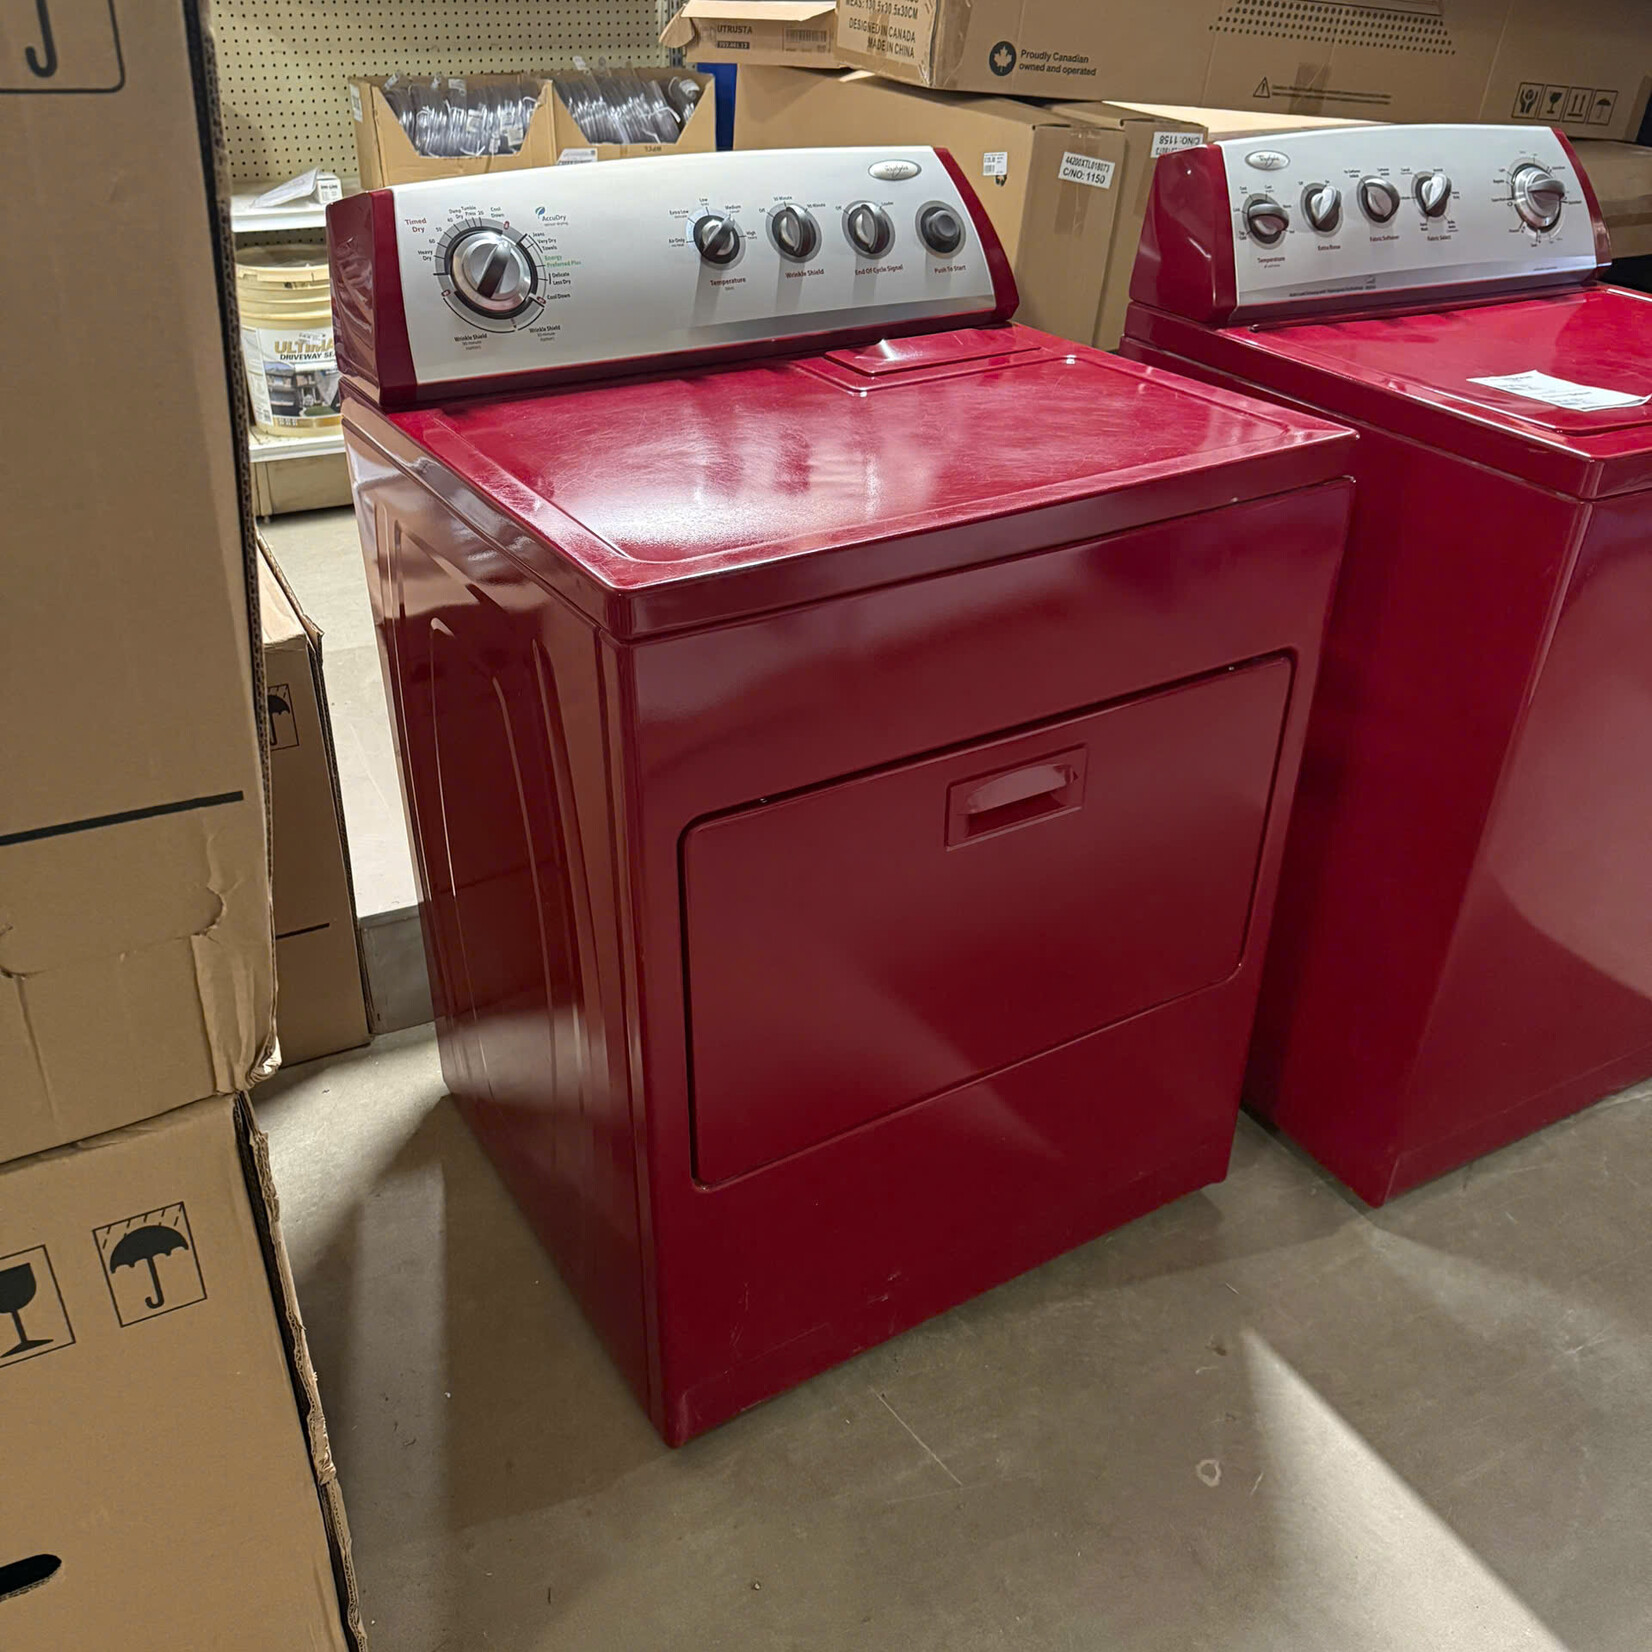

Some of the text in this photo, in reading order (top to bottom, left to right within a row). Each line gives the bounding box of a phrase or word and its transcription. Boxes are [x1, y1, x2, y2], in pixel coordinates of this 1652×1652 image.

[717, 25, 752, 34] UTRUSTA
[848, 17, 917, 43] DESIGNED IN CANADA
[867, 36, 915, 58] MADE IN CHINA
[1020, 49, 1090, 63] Proudly Canadian
[1019, 63, 1098, 76] owned and operated
[1159, 135, 1178, 145] 1158
[1063, 167, 1106, 184] C/NO: 1150
[404, 217, 427, 226] Timed
[542, 214, 567, 222] AccuDry
[785, 271, 807, 279] Wrinkle
[855, 264, 903, 276] End Of Cycle Signal
[710, 277, 746, 287] Temperature
[280, 352, 322, 360] DRIVEWAY
